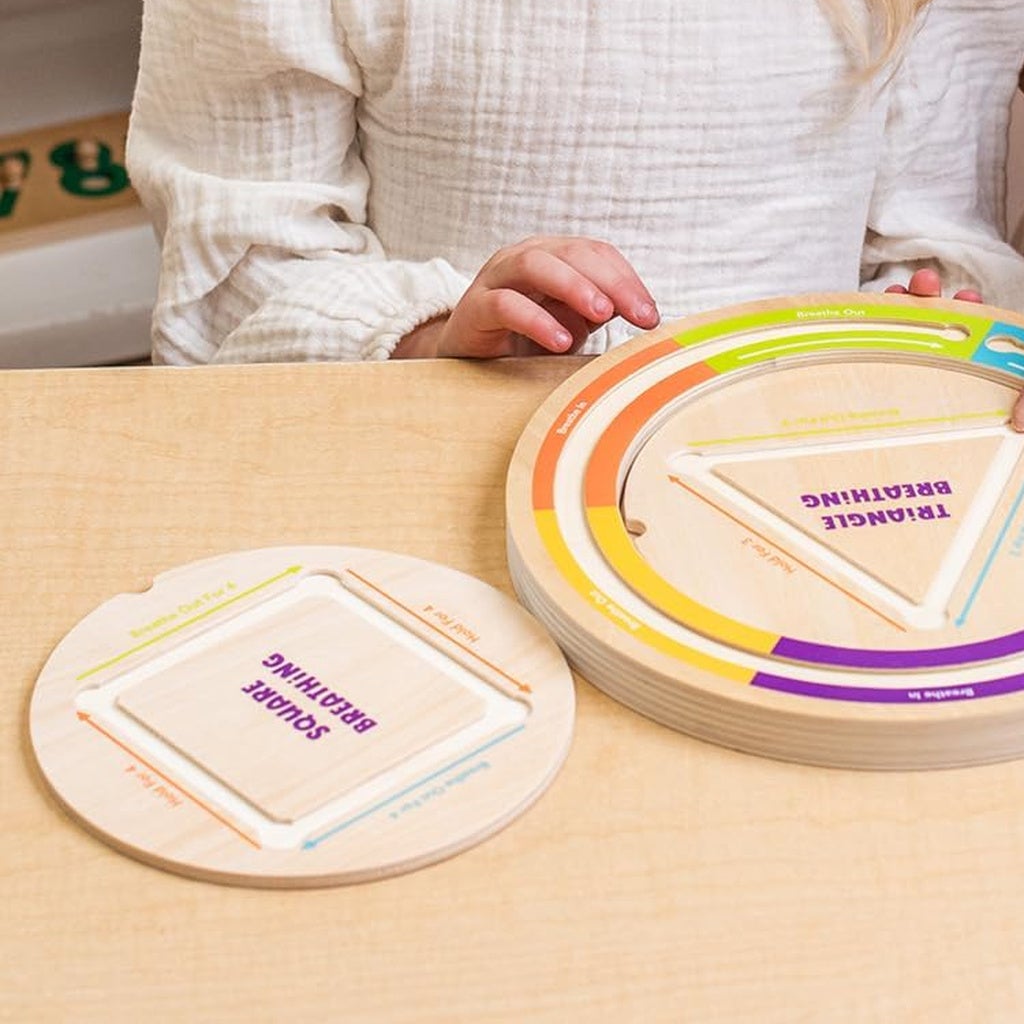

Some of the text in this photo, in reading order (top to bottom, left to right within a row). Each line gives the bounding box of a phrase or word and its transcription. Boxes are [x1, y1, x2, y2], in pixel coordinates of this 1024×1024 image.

[796, 308, 866, 319] Breathe Out
[556, 400, 588, 435] Breathe In
[751, 544, 771, 557] For
[767, 556, 799, 575] Hold
[433, 612, 454, 626] For
[450, 623, 480, 644] Hold
[907, 687, 975, 701] Breathe In
[241, 679, 331, 740] SQUARE
[137, 771, 157, 788] For
[152, 786, 183, 808] Hold
